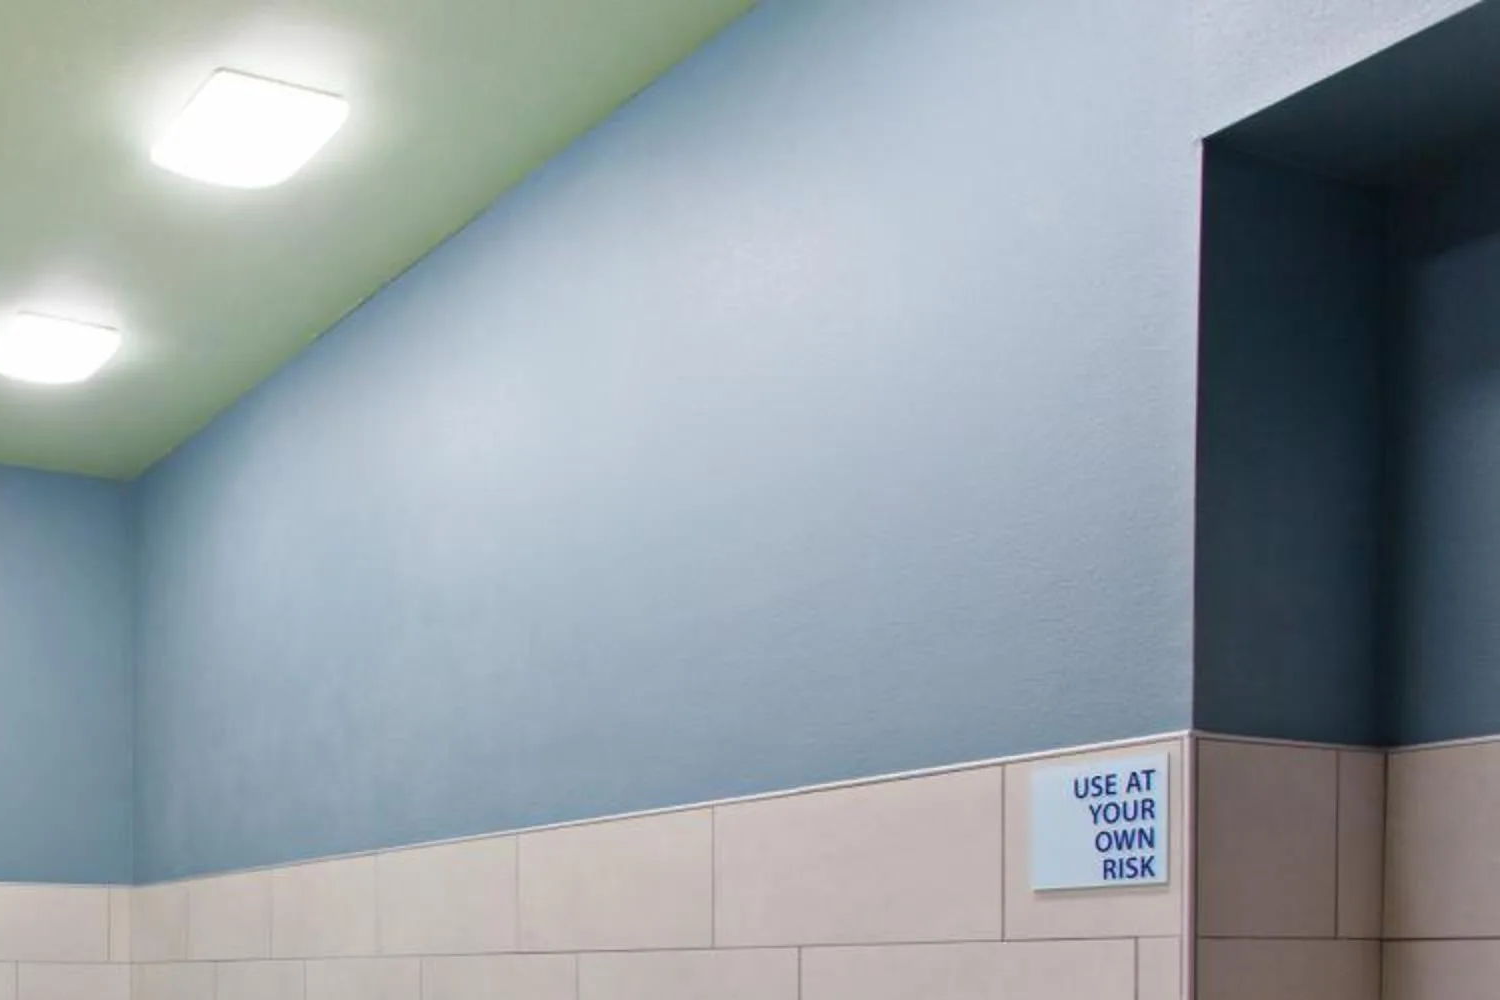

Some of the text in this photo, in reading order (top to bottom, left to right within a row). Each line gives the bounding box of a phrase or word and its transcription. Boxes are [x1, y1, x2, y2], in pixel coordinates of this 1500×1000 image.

[1073, 768, 1157, 800] USE AT
[1088, 797, 1156, 826] YOUR
[1094, 826, 1156, 853] OWN
[1102, 854, 1156, 881] RISK
